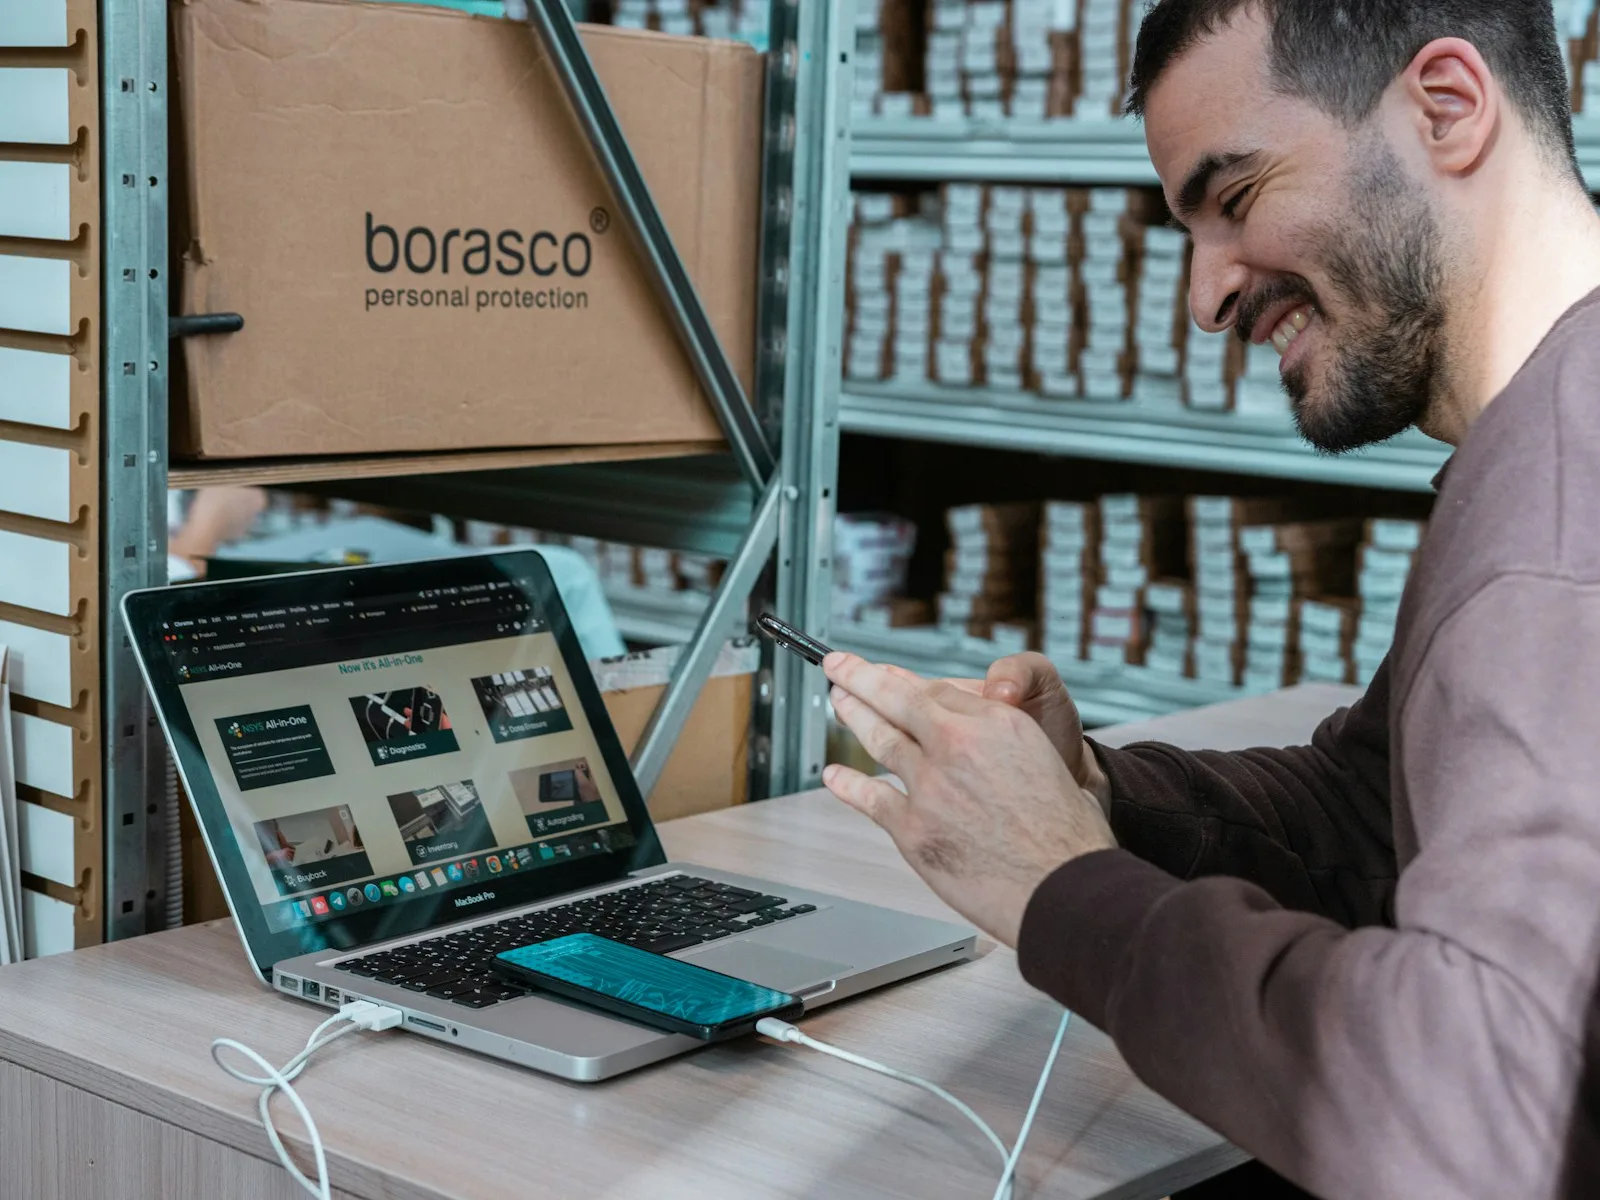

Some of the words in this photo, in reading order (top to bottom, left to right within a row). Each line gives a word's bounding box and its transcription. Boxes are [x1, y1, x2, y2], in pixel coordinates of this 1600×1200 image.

[365, 286, 469, 312] personal
[476, 287, 588, 312] protection
[208, 661, 243, 672] All-in-One
[338, 663, 361, 675] Now
[363, 659, 377, 671] it's
[379, 654, 424, 669] All-in-One
[242, 722, 265, 733] NSYS
[266, 715, 308, 730] All-in-One
[389, 741, 427, 756] Diagnostics
[427, 839, 459, 853] Inventory
[297, 869, 328, 883] Buyback
[454, 893, 484, 907] MacBook
[483, 891, 496, 901] Pro
